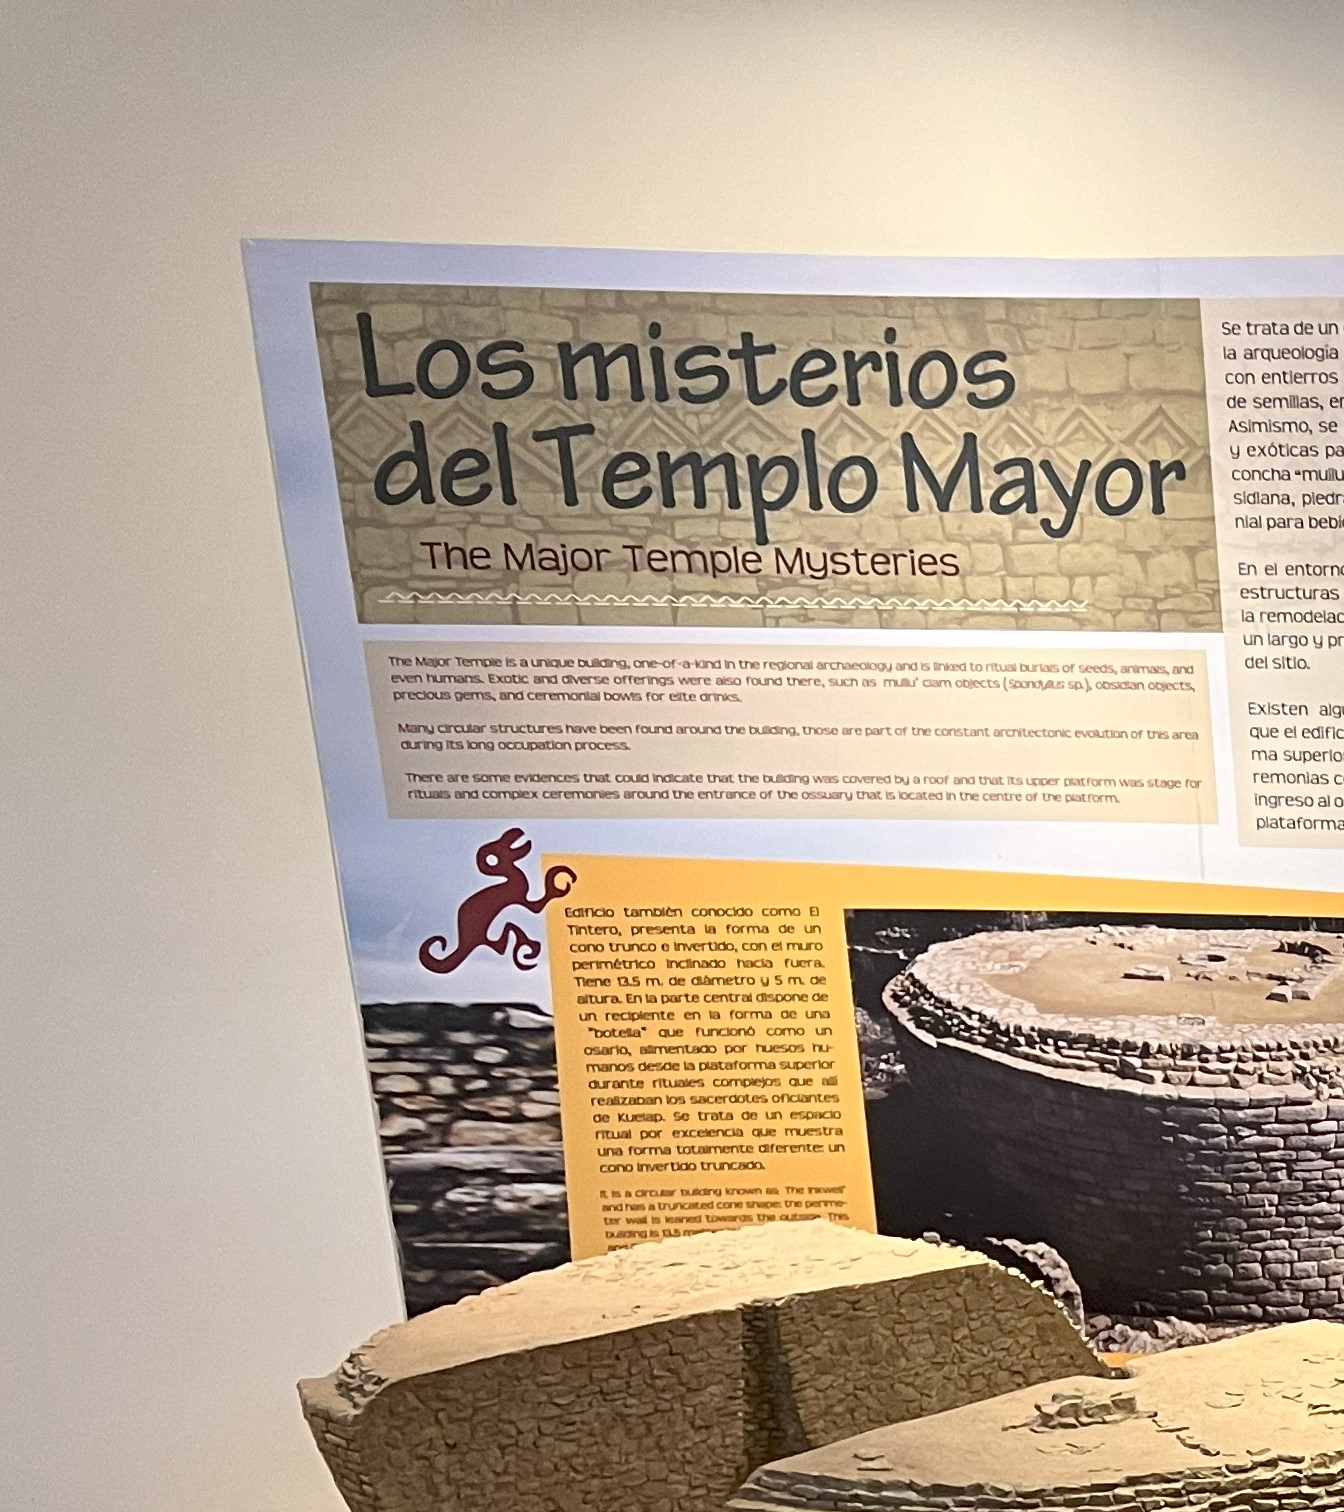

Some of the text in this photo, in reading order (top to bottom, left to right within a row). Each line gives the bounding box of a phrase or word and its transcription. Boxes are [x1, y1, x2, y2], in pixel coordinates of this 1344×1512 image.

[1221, 321, 1242, 336] Se
[1245, 321, 1290, 336] trata
[1293, 320, 1315, 336] de
[1317, 322, 1339, 336] un
[356, 311, 1016, 410] Los misterios
[1222, 345, 1237, 361] la
[1243, 343, 1339, 363] arqueología
[1224, 372, 1256, 385] con
[1261, 369, 1339, 385] entierros
[1226, 395, 1247, 409] de
[1252, 394, 1324, 411] semillas,
[1228, 418, 1313, 436] Asimismo,
[1318, 420, 1339, 433] se
[1229, 445, 1241, 460] y
[1246, 441, 1319, 458] exóticas
[373, 419, 1186, 547] del Templo Mayor
[1233, 490, 1296, 508] sidiana,
[1234, 514, 1263, 529] nial
[1266, 517, 1305, 532] para
[419, 541, 960, 580] The Major Temple Mysteries
[1237, 561, 1258, 576] En
[1264, 562, 1278, 577] el
[1239, 585, 1340, 601] estructuras
[1241, 609, 1255, 623] la
[1244, 655, 1311, 670] del sitio.
[392, 689, 452, 702] precious
[499, 690, 525, 701] and
[526, 691, 601, 702] ceremonial
[645, 691, 666, 702] for
[1247, 701, 1309, 716] Existen
[1249, 726, 1280, 740] que
[1283, 725, 1297, 739] el
[400, 739, 631, 752] during its long occupation process.
[565, 907, 614, 916] Edificio
[624, 906, 683, 918] también
[691, 907, 753, 917] conocido
[762, 908, 801, 917] como
[566, 924, 821, 938] Tintero, presenta la forma de un
[570, 940, 823, 953] cono trunco e invertido, con el muro
[572, 960, 656, 972] perimétrico
[666, 958, 726, 969] inclinado
[737, 958, 773, 968] hacia
[586, 1060, 835, 1073] manos desde la plataforma superior
[588, 1079, 644, 1090] durante
[652, 1078, 705, 1088] rituales
[713, 1076, 781, 1088] complejos
[789, 1078, 813, 1088] que
[665, 1094, 686, 1105] los
[690, 1094, 768, 1104] sacerdotes
[772, 1093, 840, 1103] oficiantes
[600, 1161, 766, 1173] cono invertido truncado.
